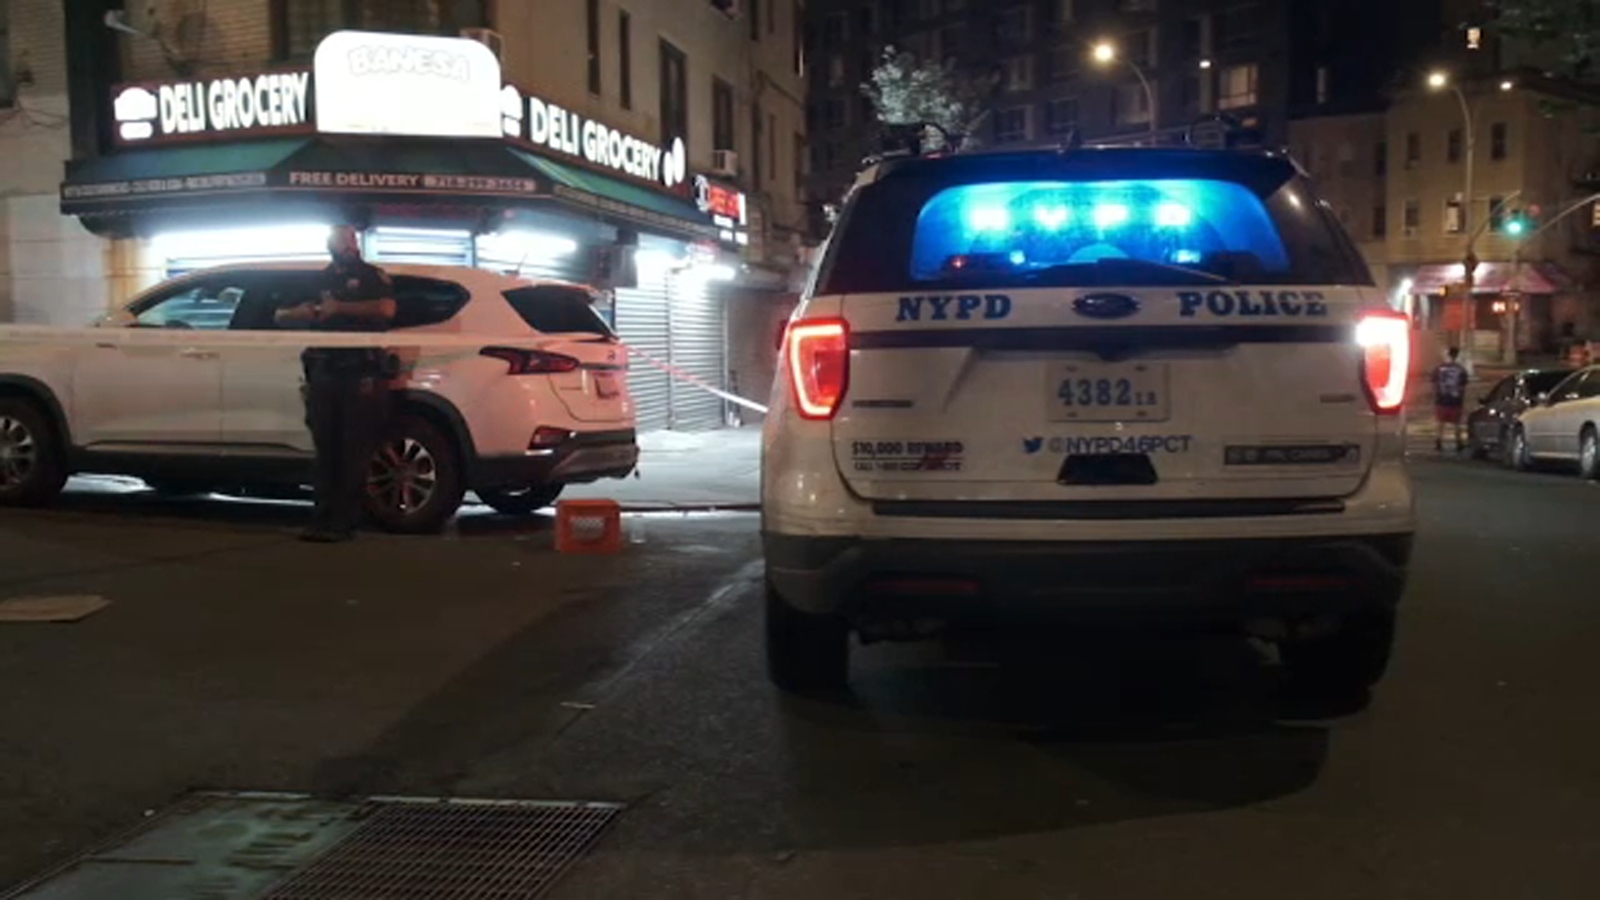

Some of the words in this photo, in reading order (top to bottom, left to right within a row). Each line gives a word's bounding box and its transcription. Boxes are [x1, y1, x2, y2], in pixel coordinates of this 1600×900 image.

[349, 46, 471, 82] BANESA
[159, 83, 205, 133] DELI
[208, 72, 309, 130] GROCERY
[529, 97, 579, 156] DELI
[582, 120, 661, 182] GROCERY
[289, 172, 332, 184] FREE
[336, 173, 419, 187] DELIVERY
[896, 294, 1012, 321] NYPD
[1176, 291, 1327, 317] POLICE
[1057, 378, 1132, 406] 4382
[851, 441, 902, 458] $10,000
[1048, 435, 1192, 454] @NYPD46PCT
